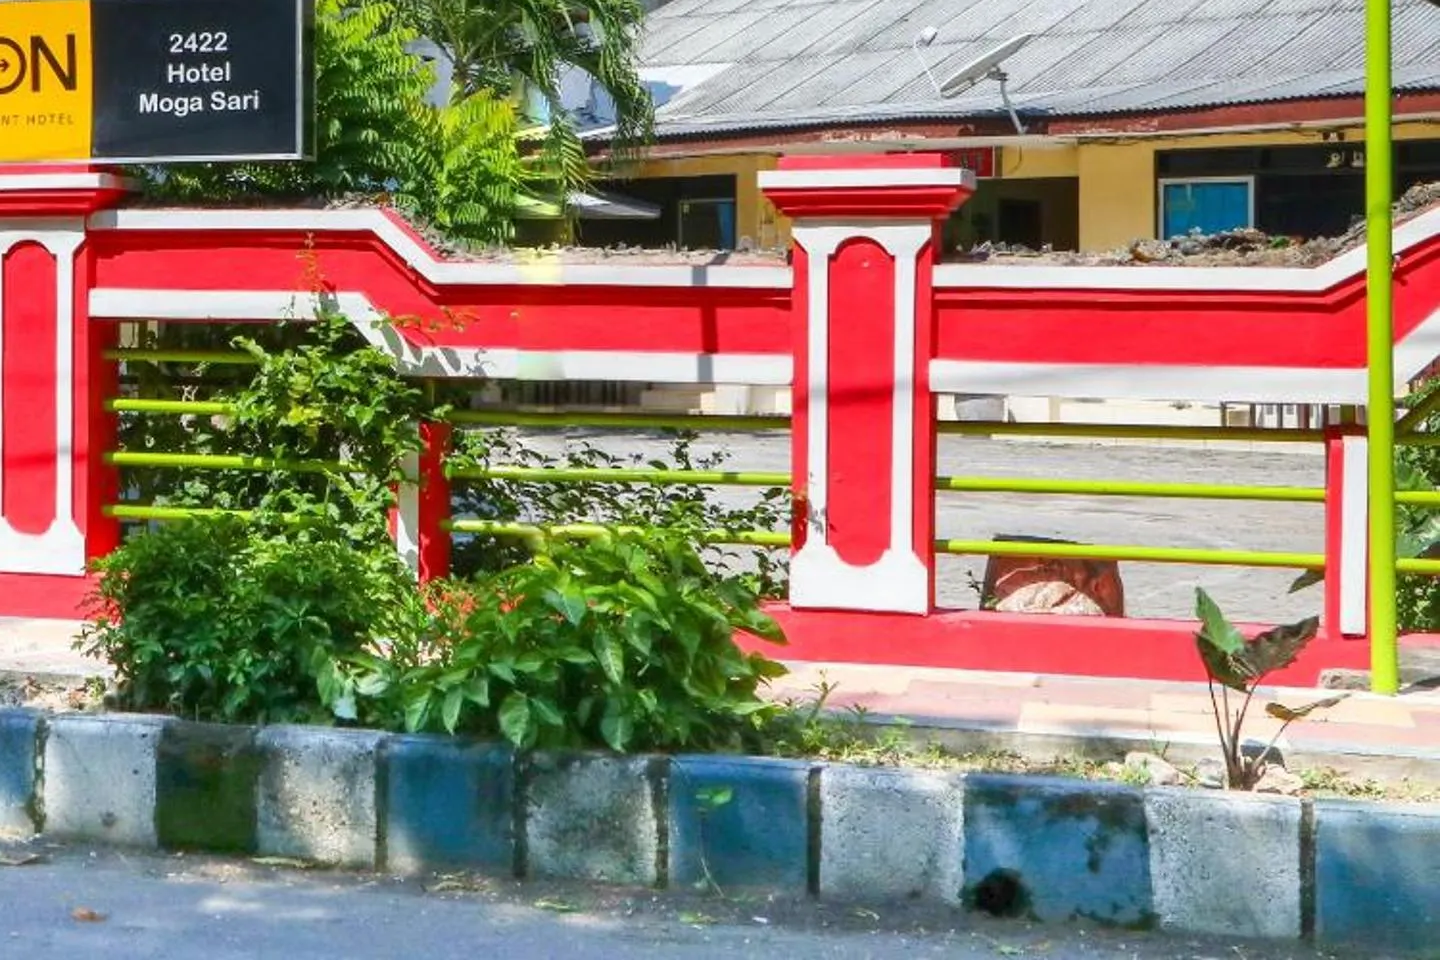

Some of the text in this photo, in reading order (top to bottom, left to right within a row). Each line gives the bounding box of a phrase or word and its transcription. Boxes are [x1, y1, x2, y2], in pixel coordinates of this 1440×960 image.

[169, 32, 228, 53] 2422
[167, 60, 231, 83] Hotel
[139, 89, 259, 117] Moga Sari
[26, 113, 75, 126] HOTEL
